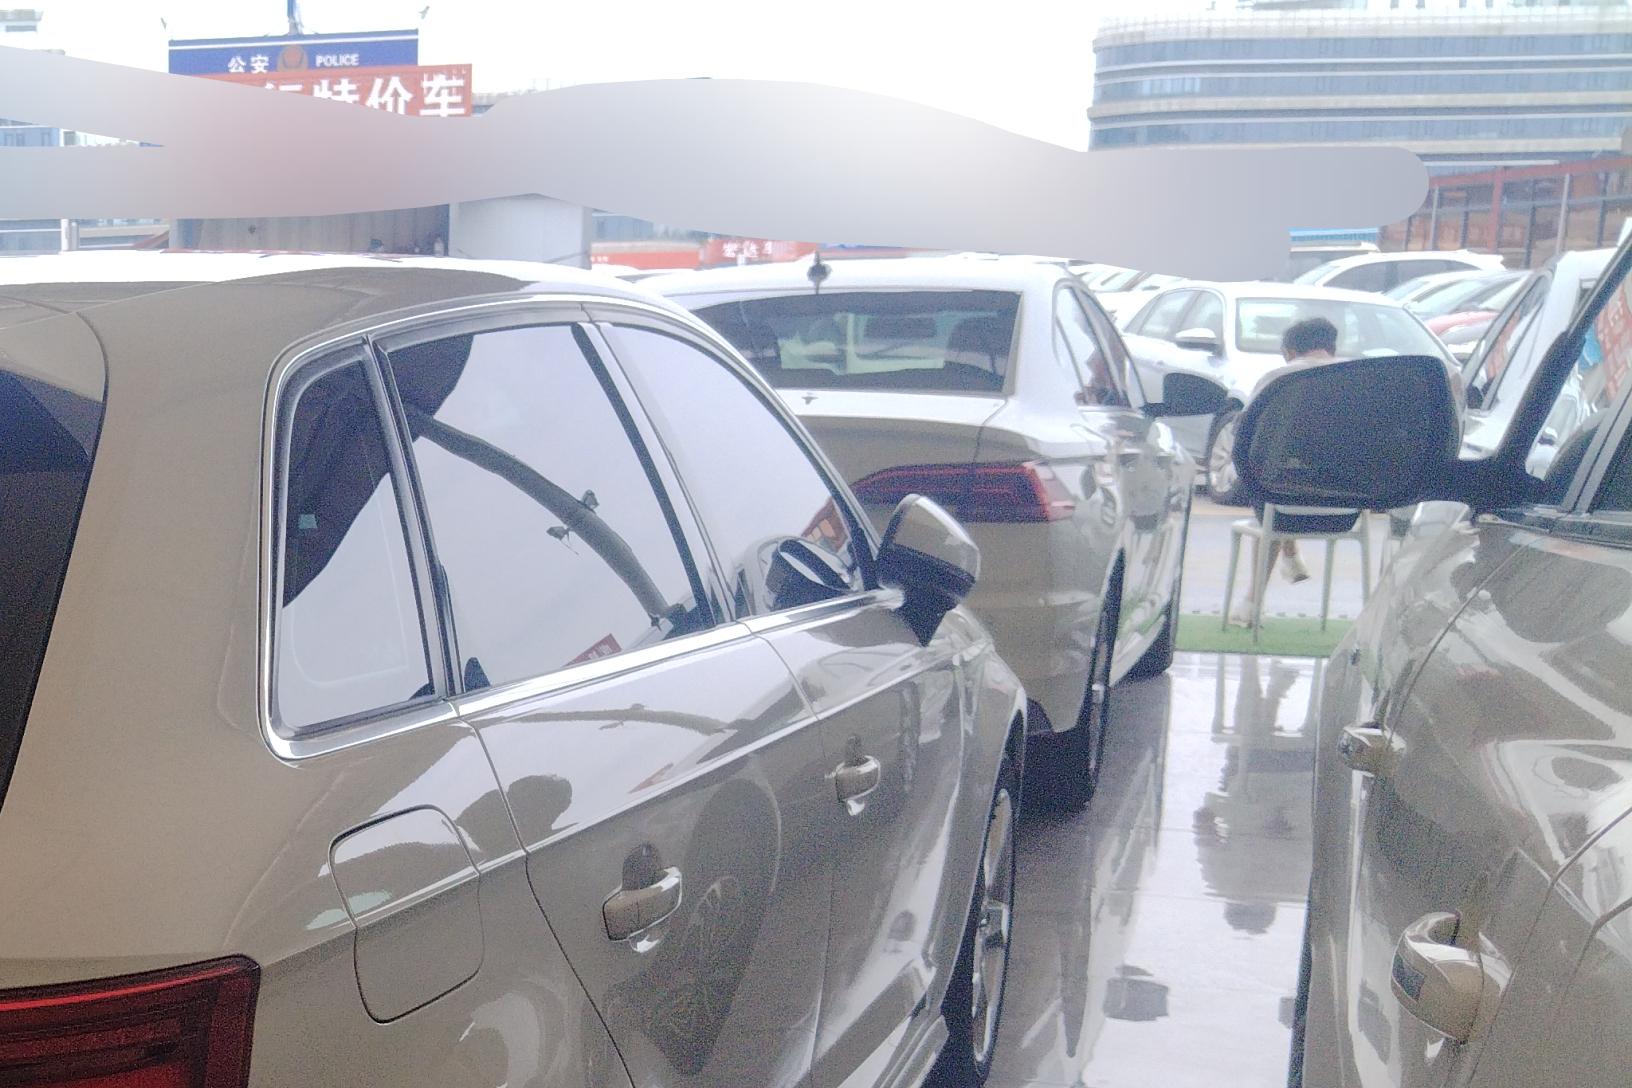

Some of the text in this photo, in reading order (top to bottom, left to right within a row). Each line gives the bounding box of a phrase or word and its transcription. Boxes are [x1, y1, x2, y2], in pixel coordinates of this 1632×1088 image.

[227, 53, 360, 74] 公安 POLICE
[263, 73, 466, 117] 特价车
